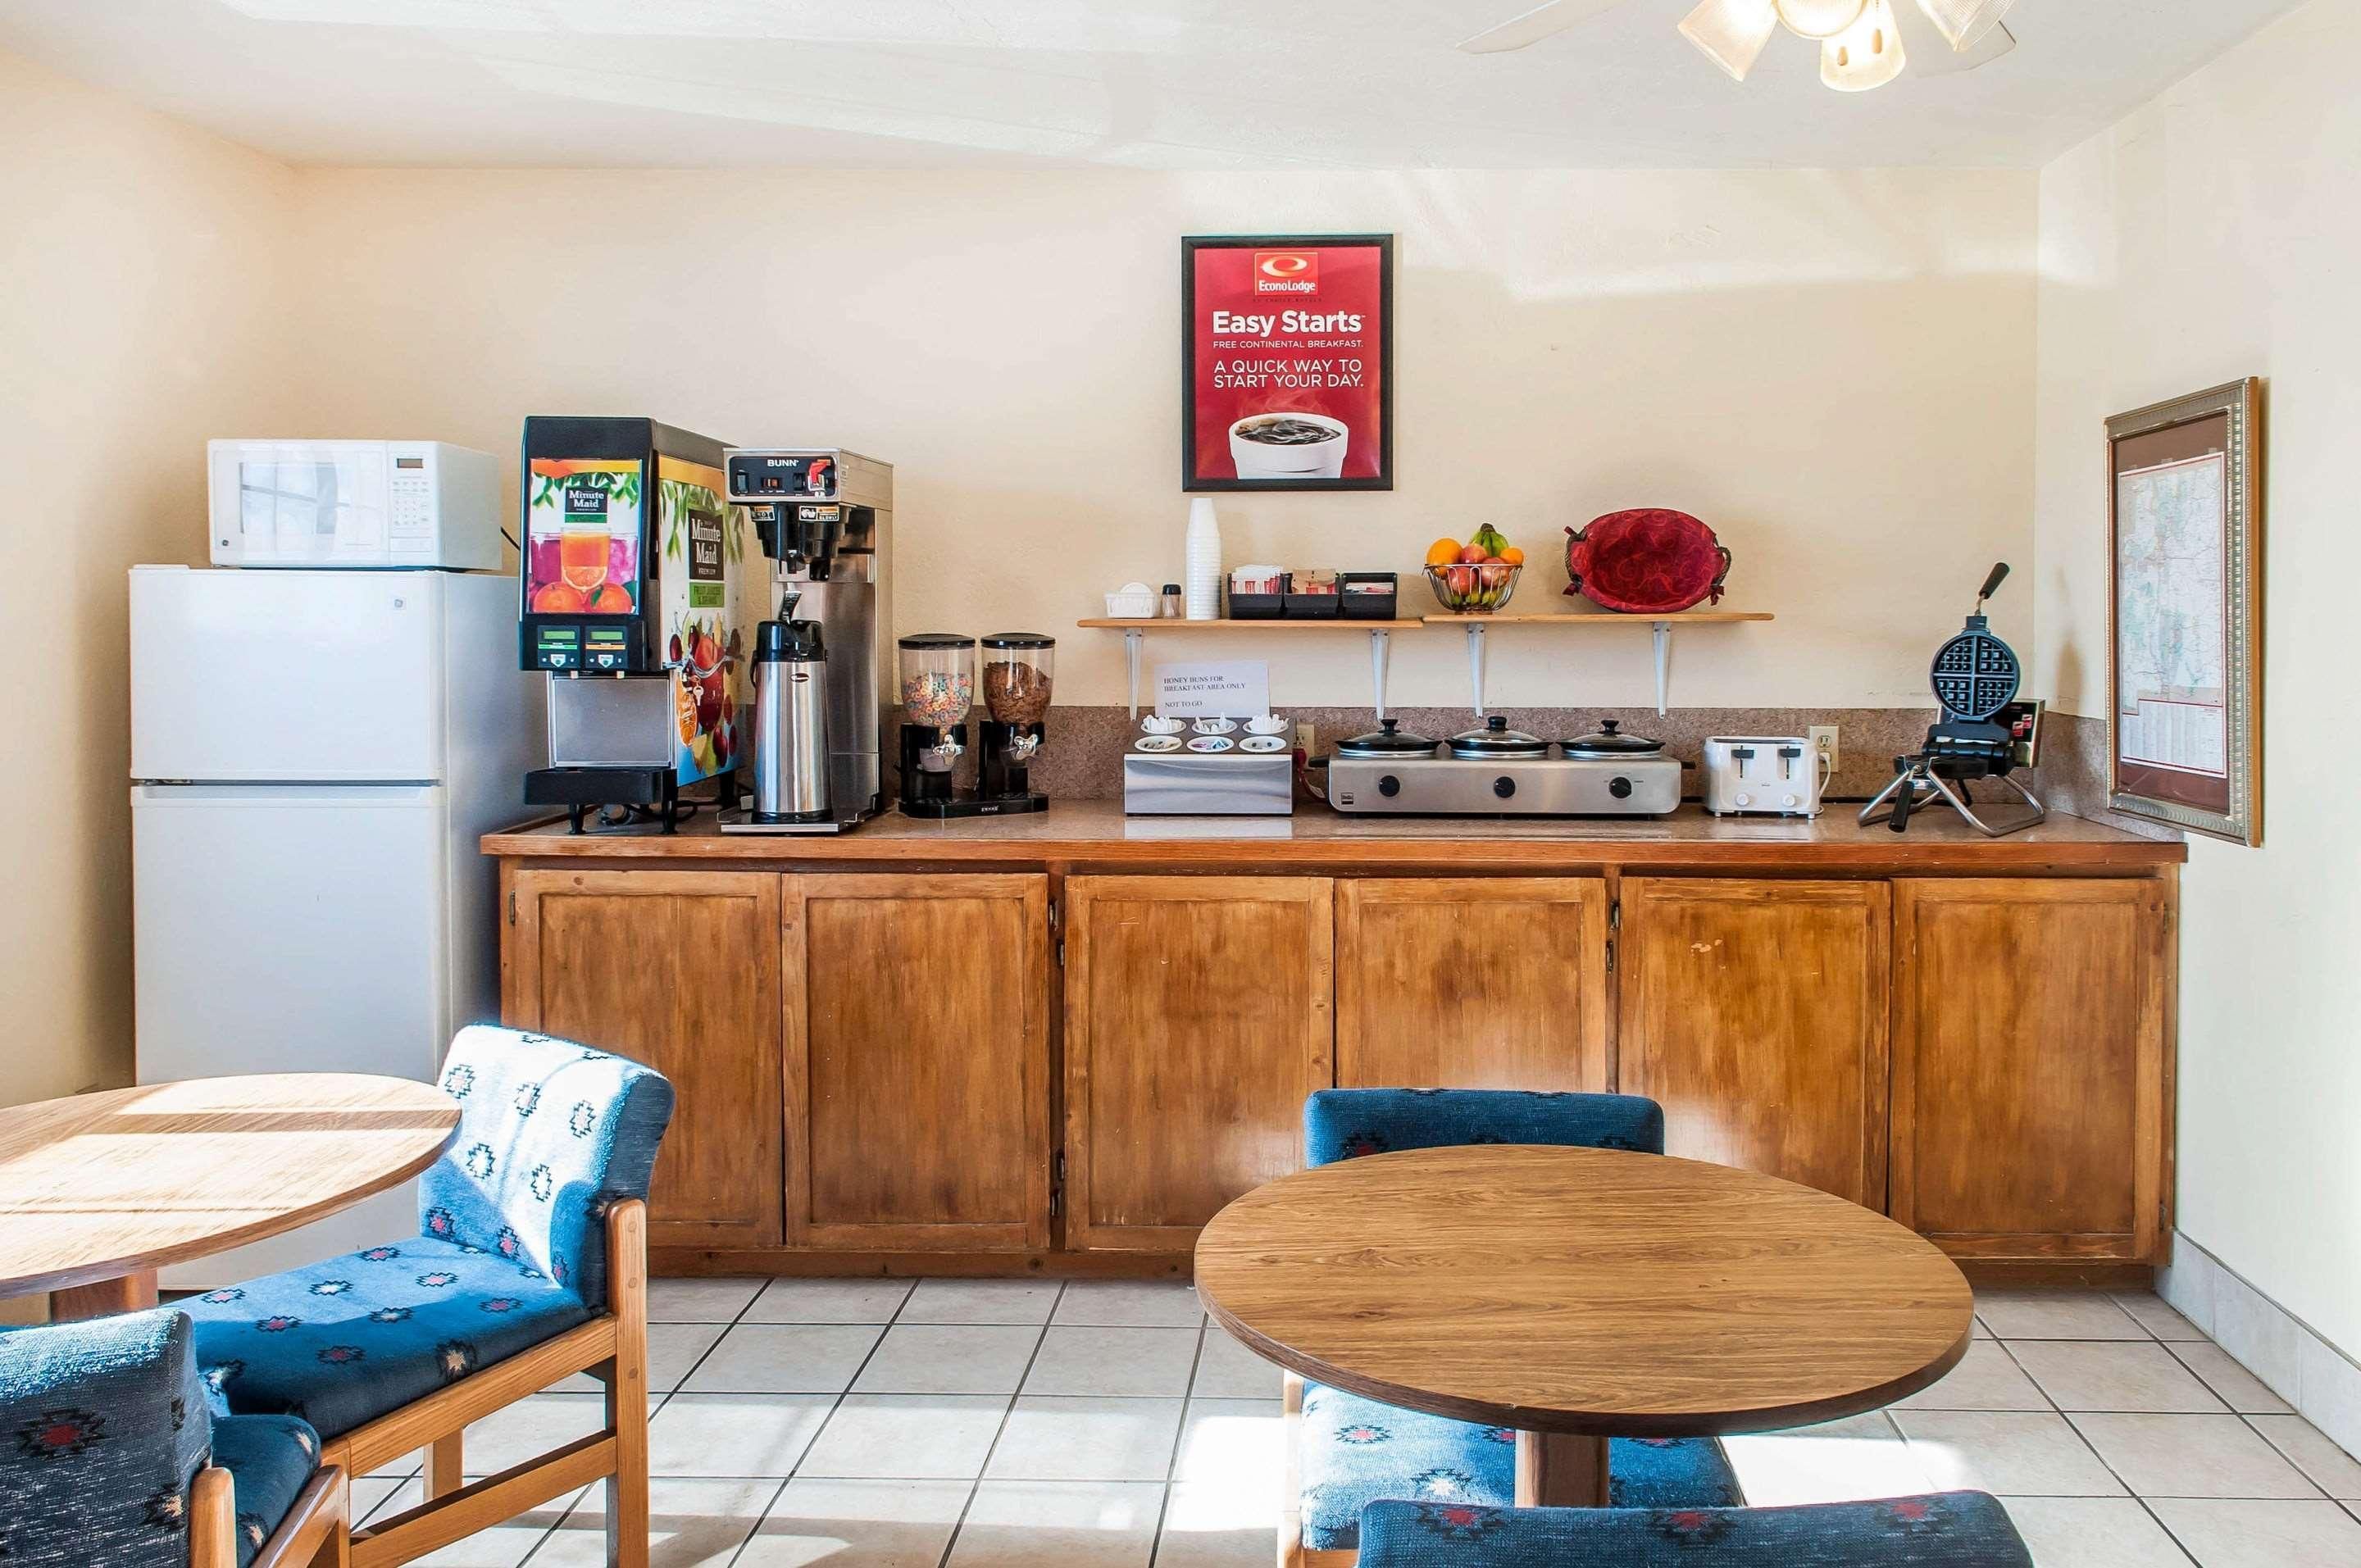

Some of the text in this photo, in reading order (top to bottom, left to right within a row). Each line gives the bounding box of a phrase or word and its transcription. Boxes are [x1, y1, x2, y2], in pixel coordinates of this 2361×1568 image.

[1258, 280, 1316, 293] EconoLodge
[1213, 310, 1362, 338] Easy Starts
[1240, 340, 1305, 348] CONTINENTAL
[1308, 339, 1364, 348] BREAKFAST.
[1213, 359, 1362, 374] A QUICK WAY TO
[1214, 373, 1364, 388] START YOUR DAY.
[767, 459, 798, 467] BUNN
[569, 490, 604, 499] Minute
[574, 498, 599, 508] Maid
[691, 518, 721, 543] Minute
[695, 542, 717, 564] Maid
